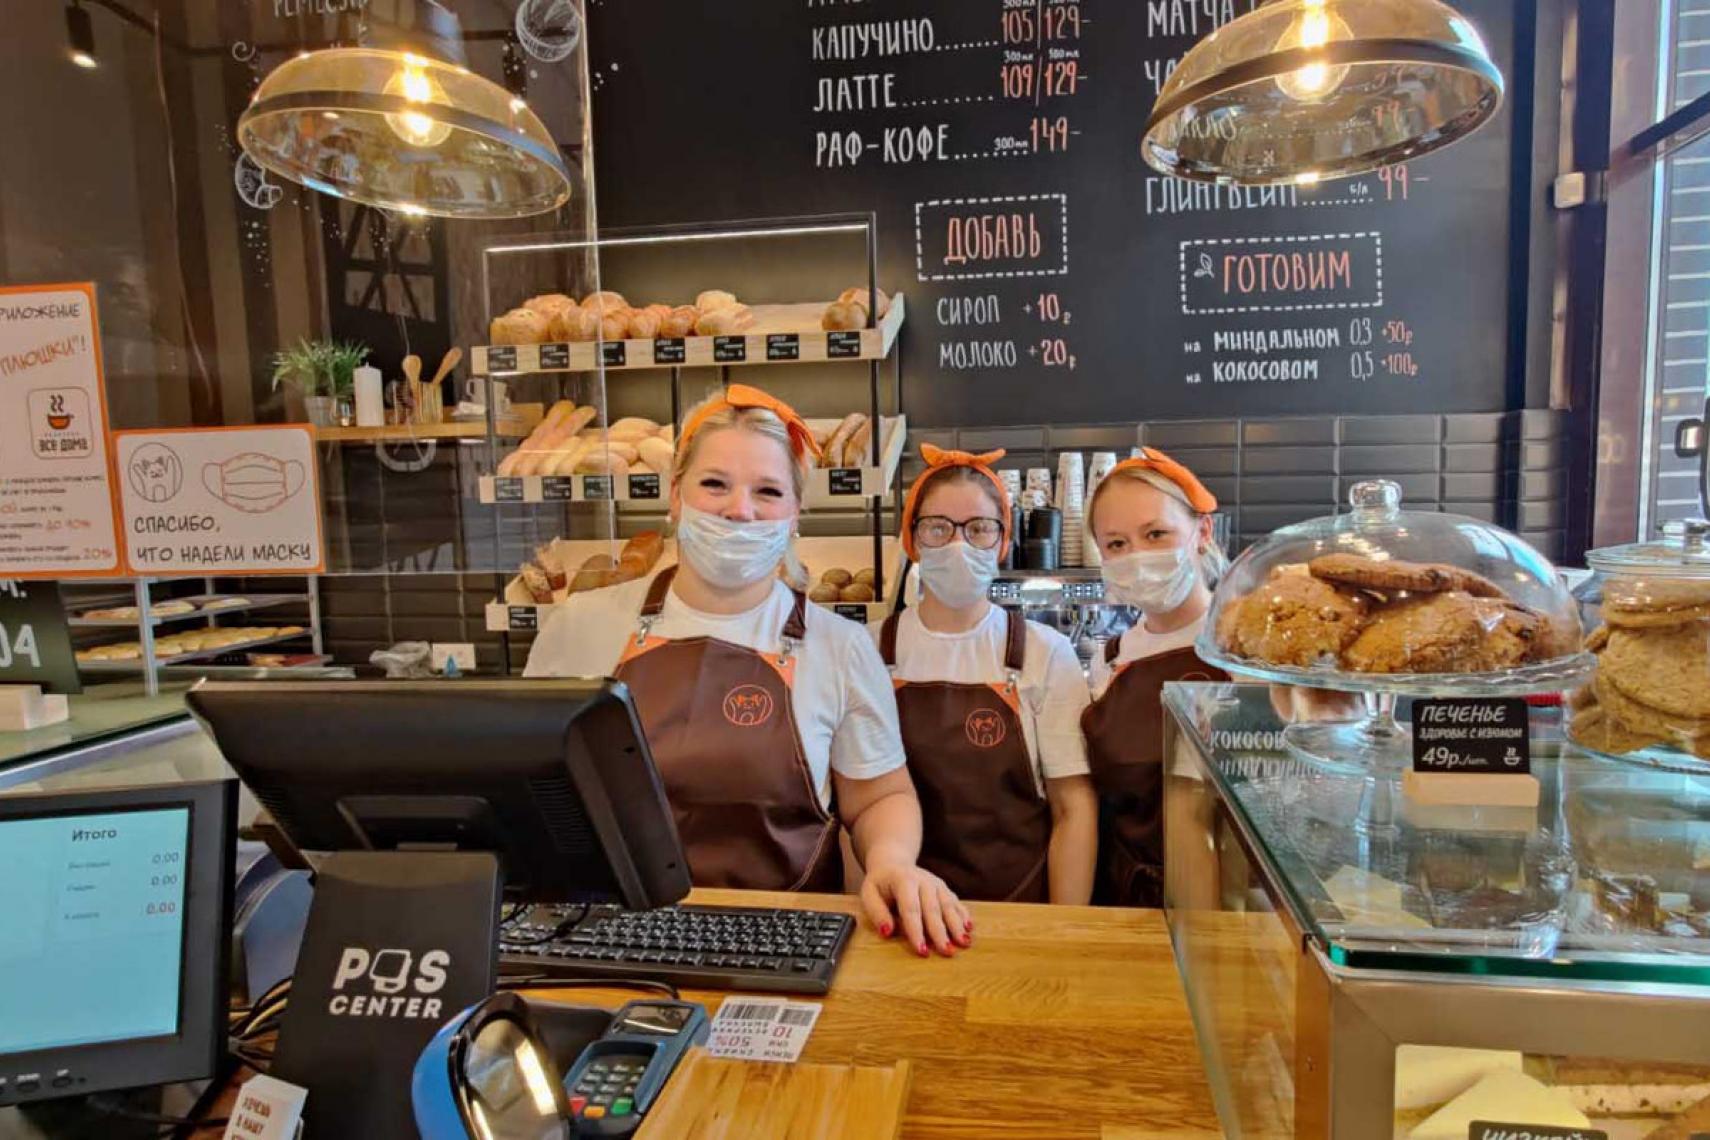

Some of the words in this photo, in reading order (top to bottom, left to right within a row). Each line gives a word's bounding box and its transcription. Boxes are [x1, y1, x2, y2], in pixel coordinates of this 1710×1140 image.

[1147, 0, 1235, 38] МАТЧА
[812, 18, 935, 60] КАПУЧИНО
[813, 74, 897, 111] ЛАТТЕ
[815, 124, 950, 168] РАФ-КОФЕ
[943, 213, 1042, 266] ДОБАВЬ
[1223, 250, 1351, 294] ГОТОВИМ
[936, 294, 1000, 326] СИРОП
[940, 340, 1017, 370] МОЛОКО
[1213, 327, 1340, 354] МИНДАЛЬНОМ
[1213, 358, 1319, 383] КОКОСОВОМ
[134, 514, 221, 534] СПАСИБО,
[137, 546, 173, 562] ЧТО
[181, 545, 245, 564] НАДЕЛИ
[252, 543, 312, 561] МАСКУ
[1421, 704, 1507, 723] ПЕЧЕНЬЕ
[72, 828, 117, 843] Итого
[328, 995, 443, 1019] CENTER
